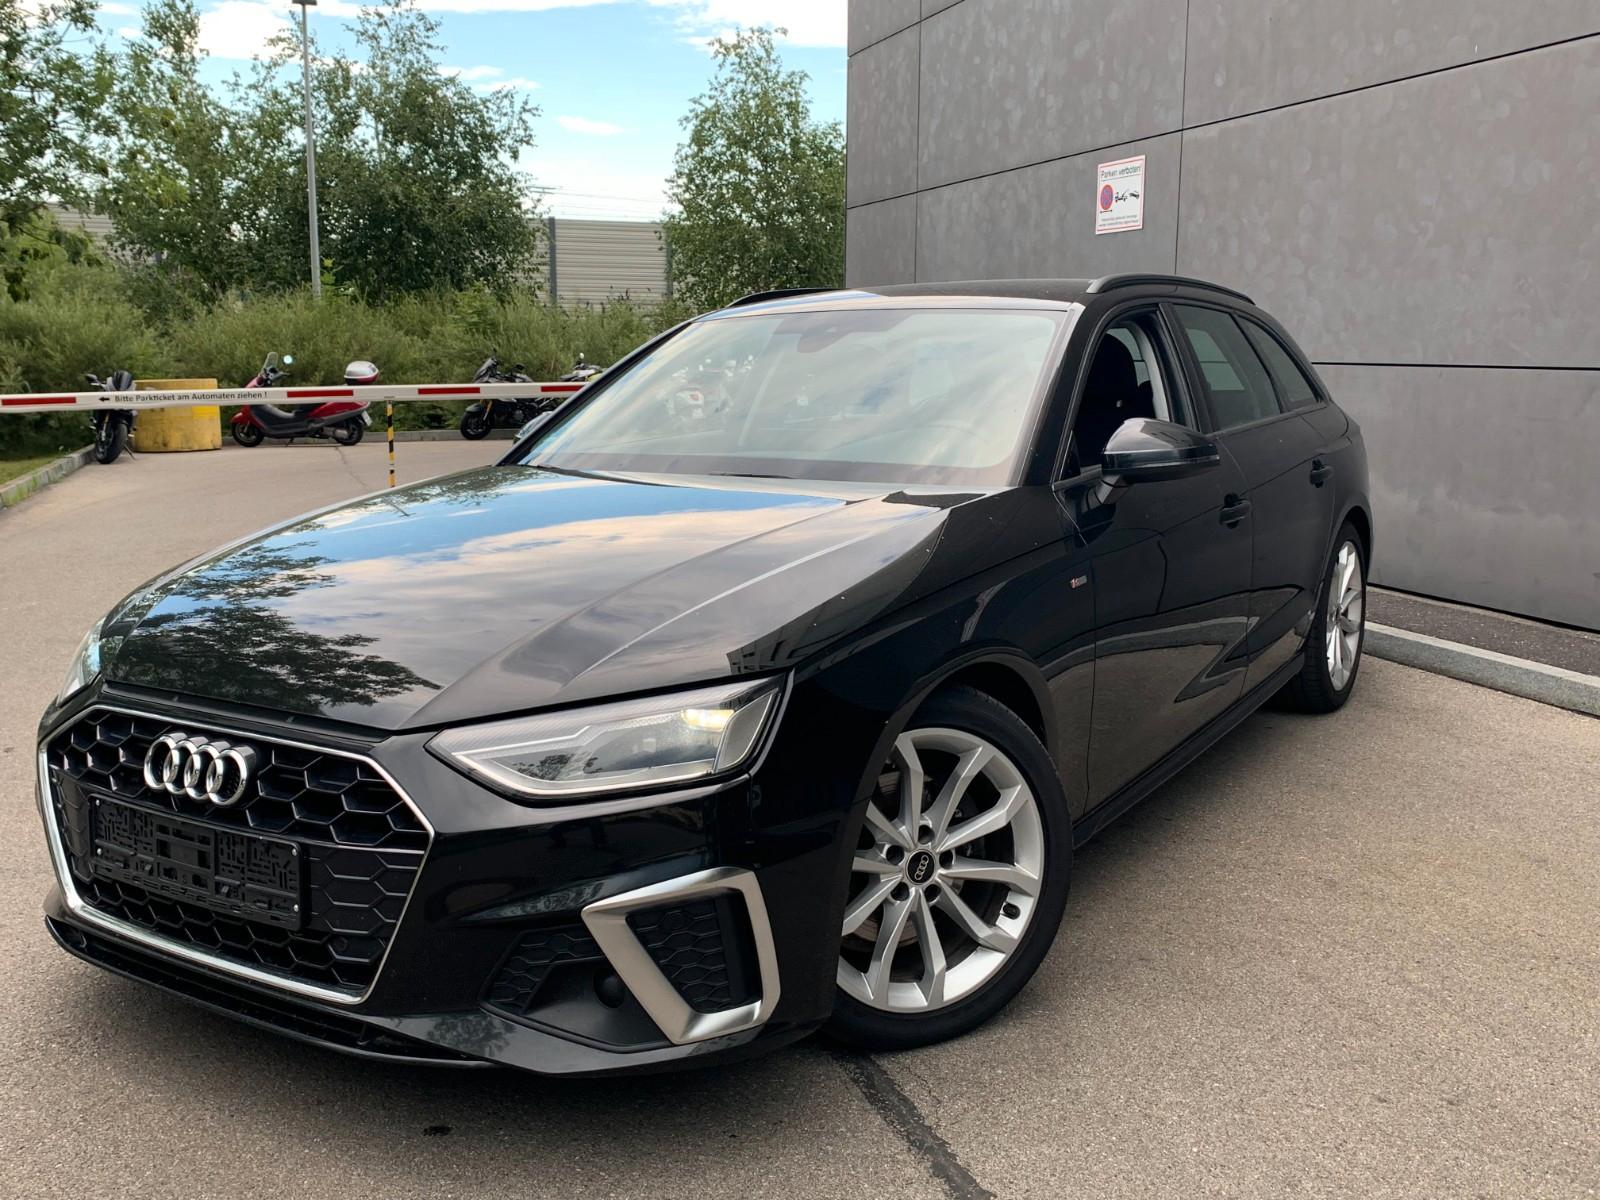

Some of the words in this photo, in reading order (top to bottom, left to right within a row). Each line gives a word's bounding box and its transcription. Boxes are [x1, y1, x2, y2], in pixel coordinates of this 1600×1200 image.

[114, 394, 134, 402] Bitte
[135, 394, 175, 402] Parkticket
[191, 392, 236, 401] Automaten
[236, 391, 262, 399] ziehen
